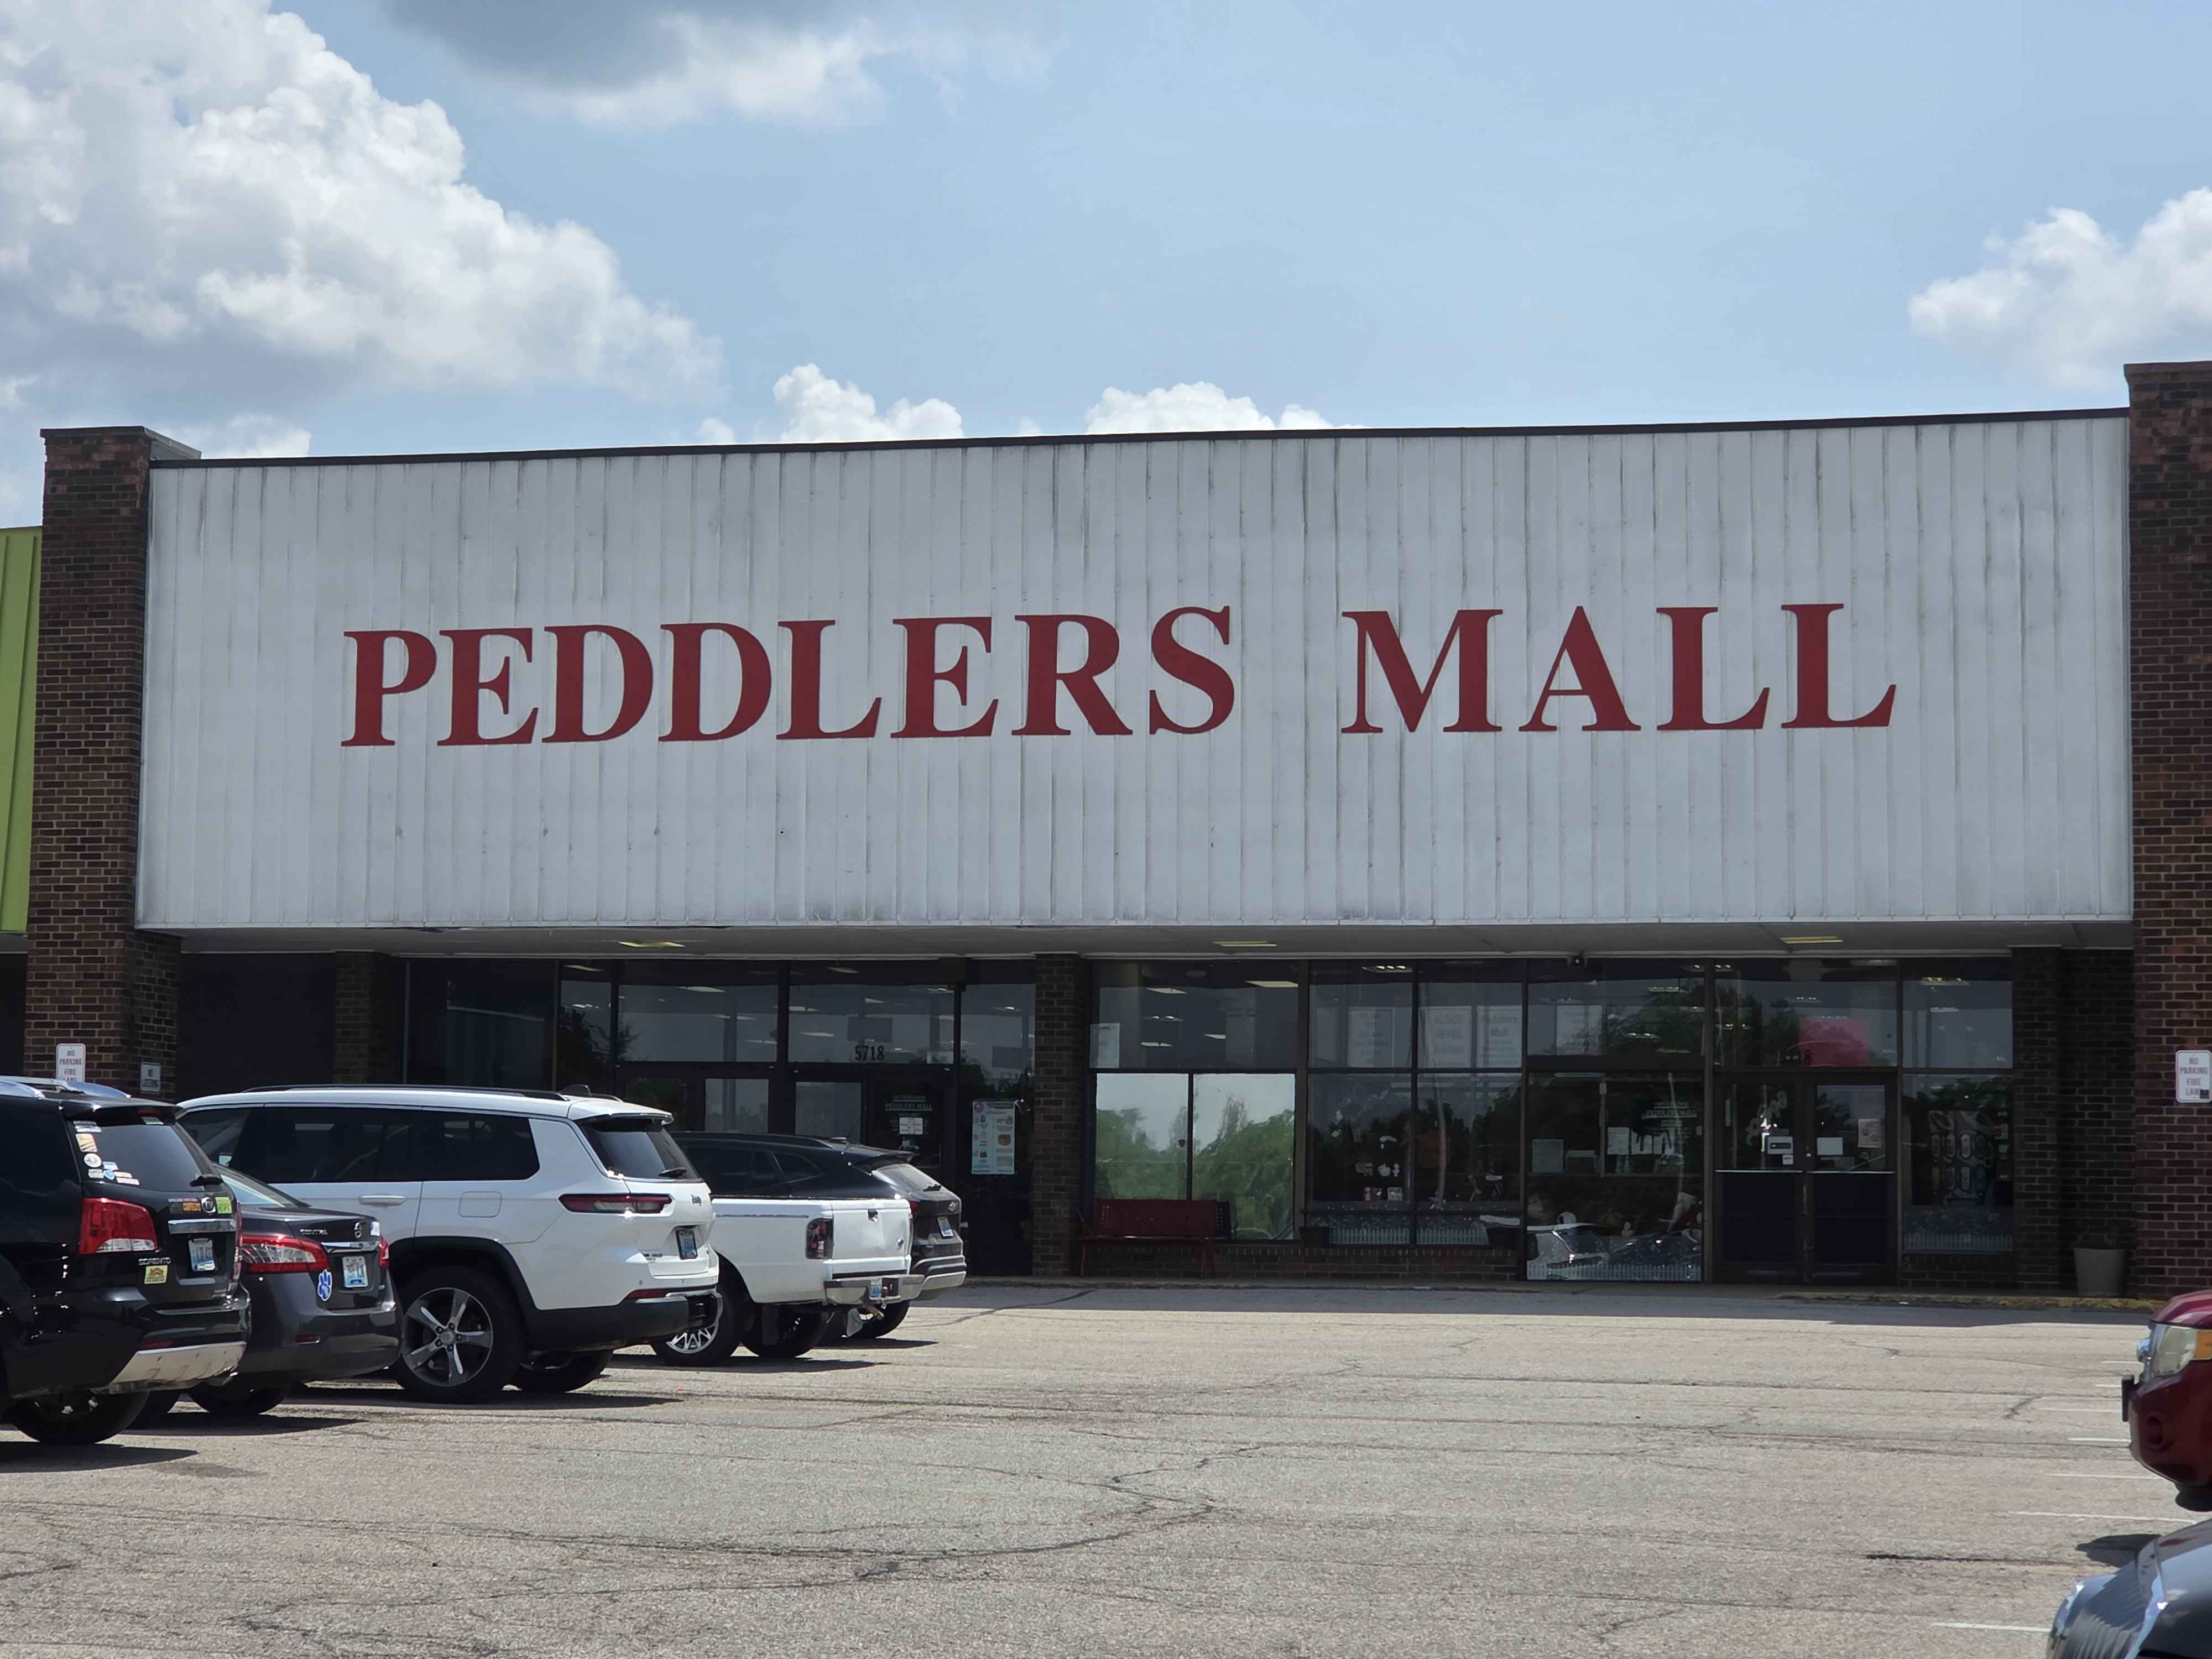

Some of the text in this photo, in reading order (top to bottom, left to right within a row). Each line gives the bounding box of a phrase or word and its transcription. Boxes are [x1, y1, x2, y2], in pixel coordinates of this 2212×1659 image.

[341, 603, 1896, 746] PEDDLERS MALL
[855, 1045, 884, 1061] 5718
